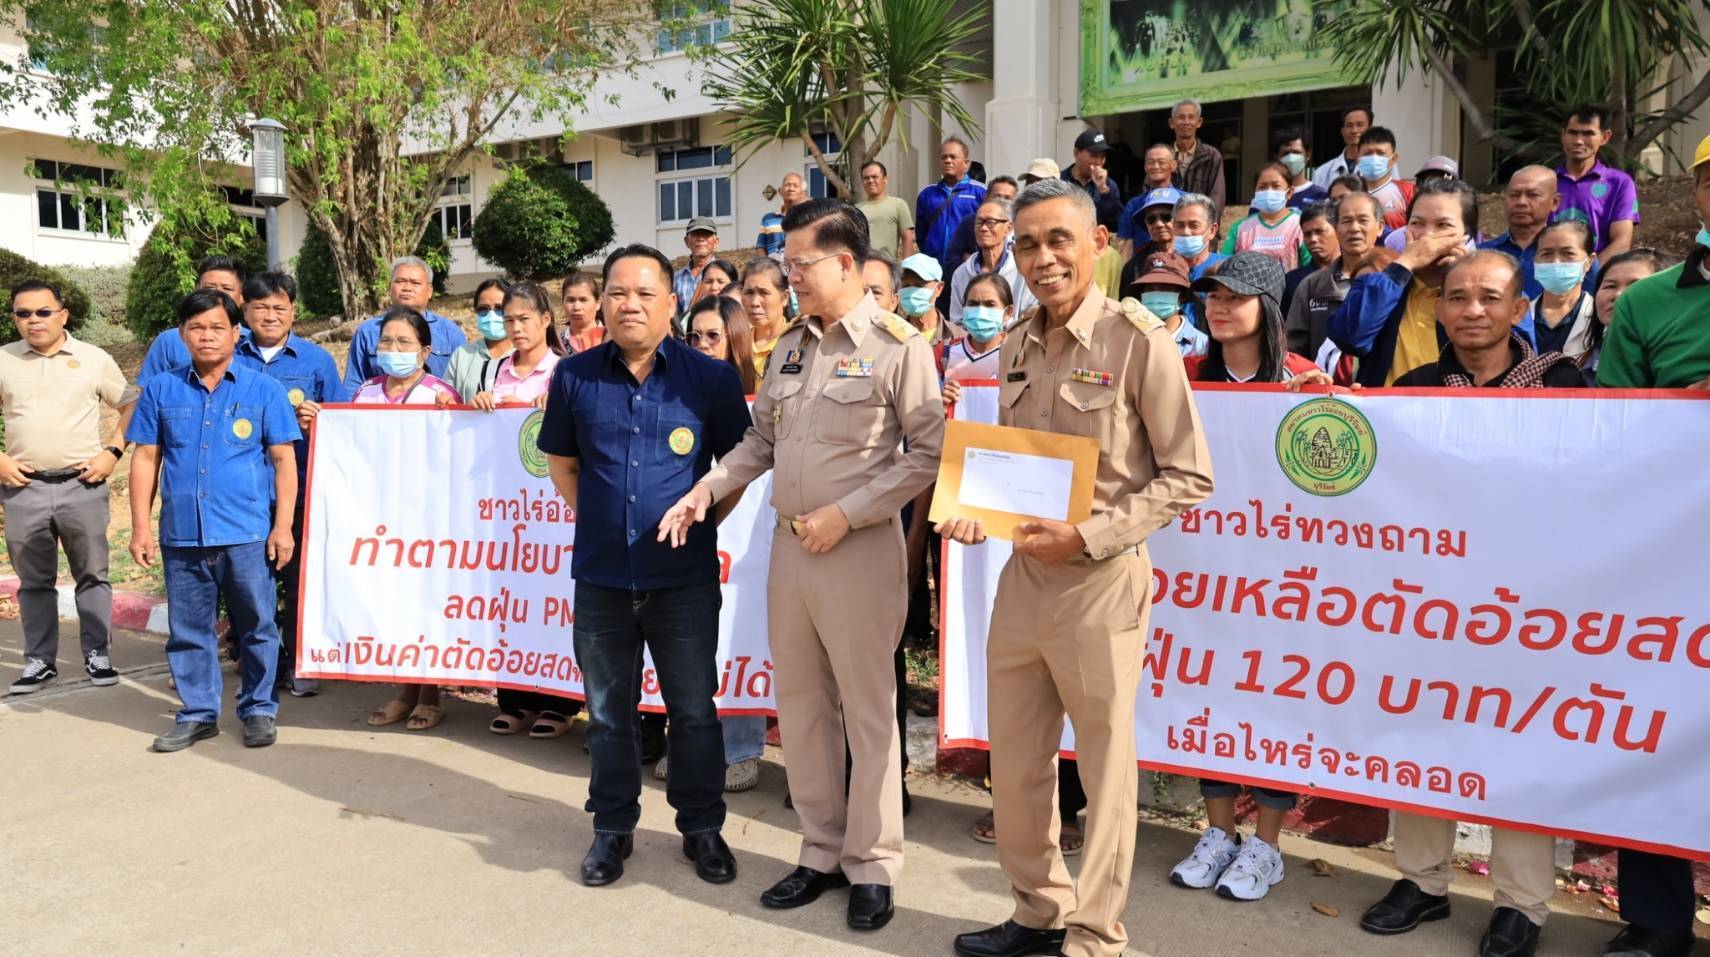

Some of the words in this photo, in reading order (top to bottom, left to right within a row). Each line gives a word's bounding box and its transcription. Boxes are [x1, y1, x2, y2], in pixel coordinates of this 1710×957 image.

[478, 488, 577, 523] ชาวไร่อ้อ
[1178, 498, 1467, 558] ชาวไร่ทวงถาม
[443, 586, 529, 632] ลดฝุ่น
[1234, 648, 1357, 706] 120
[1377, 673, 1667, 755] บาท/ตัน
[1166, 706, 1488, 801] เมื่อไหร่จะคลอด
